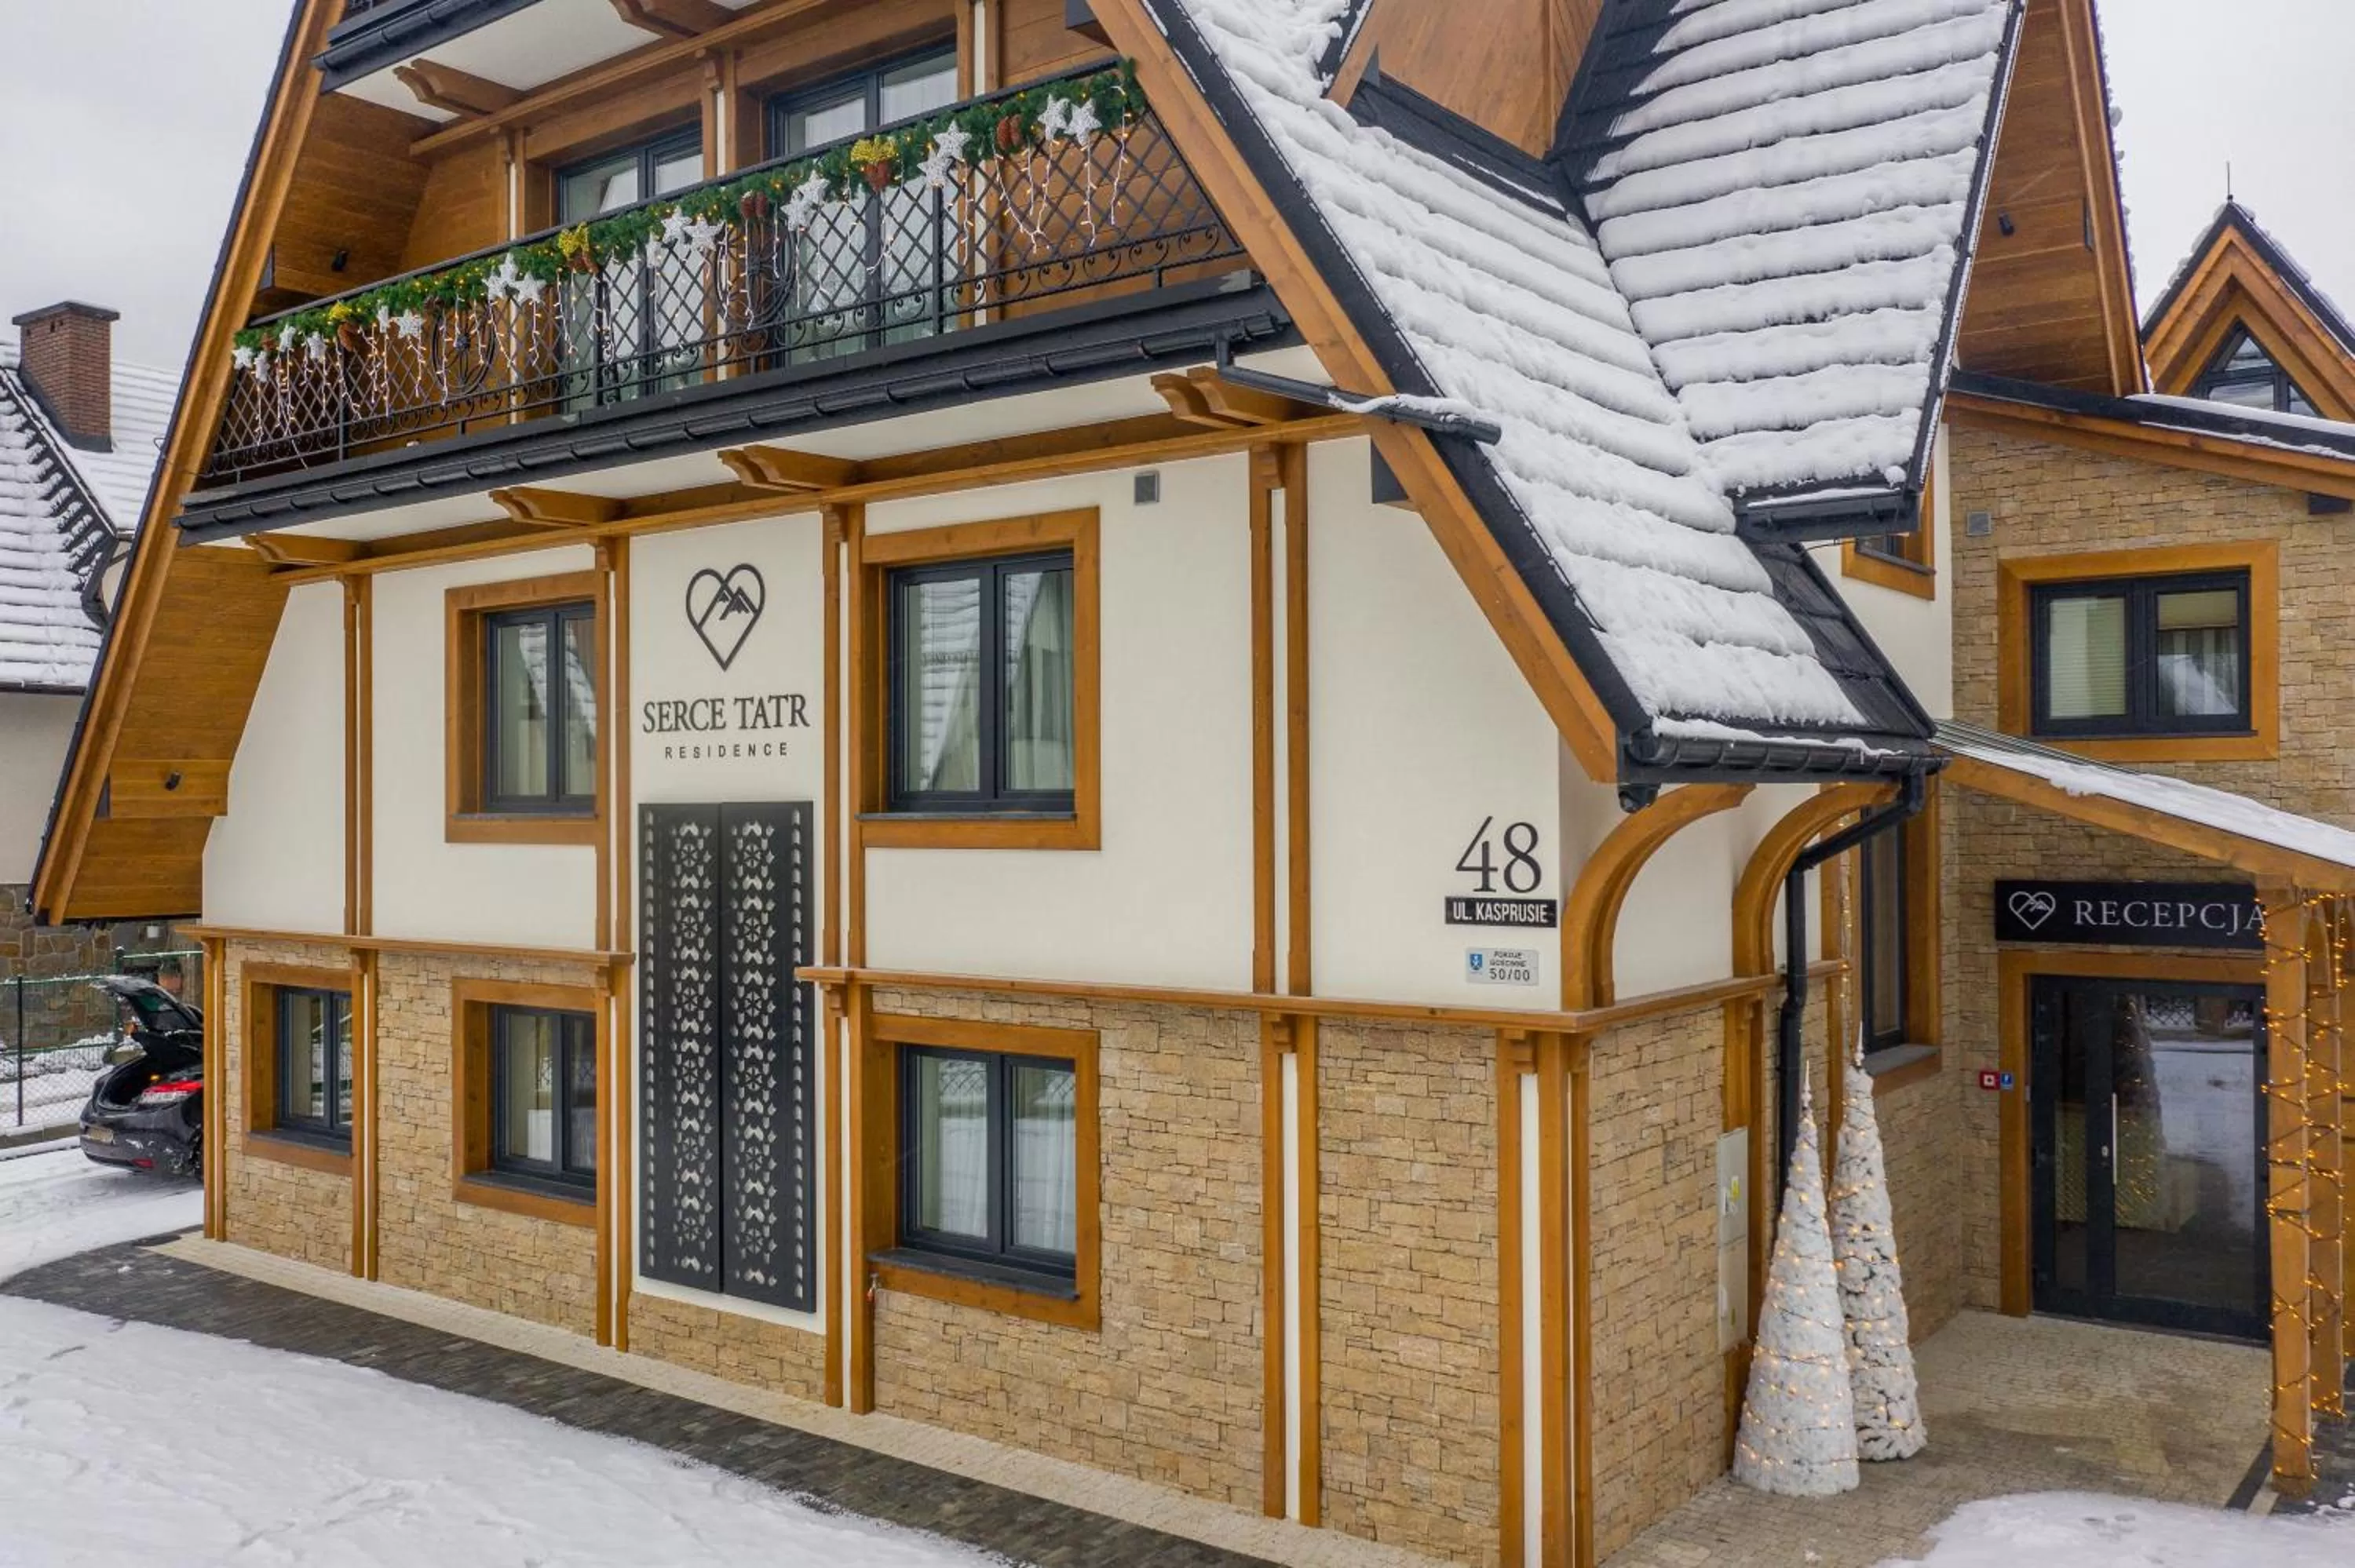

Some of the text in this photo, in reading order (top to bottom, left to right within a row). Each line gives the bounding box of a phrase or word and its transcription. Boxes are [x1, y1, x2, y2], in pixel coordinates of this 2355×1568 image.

[642, 694, 810, 734] SERCE TATR
[665, 742, 788, 760] RESIDENCE
[1455, 815, 1543, 894] 48
[1452, 901, 1549, 924] UL. KASPRUSIE
[2073, 899, 2266, 936] RECEPCJA
[1488, 968, 1531, 982] 50/00
